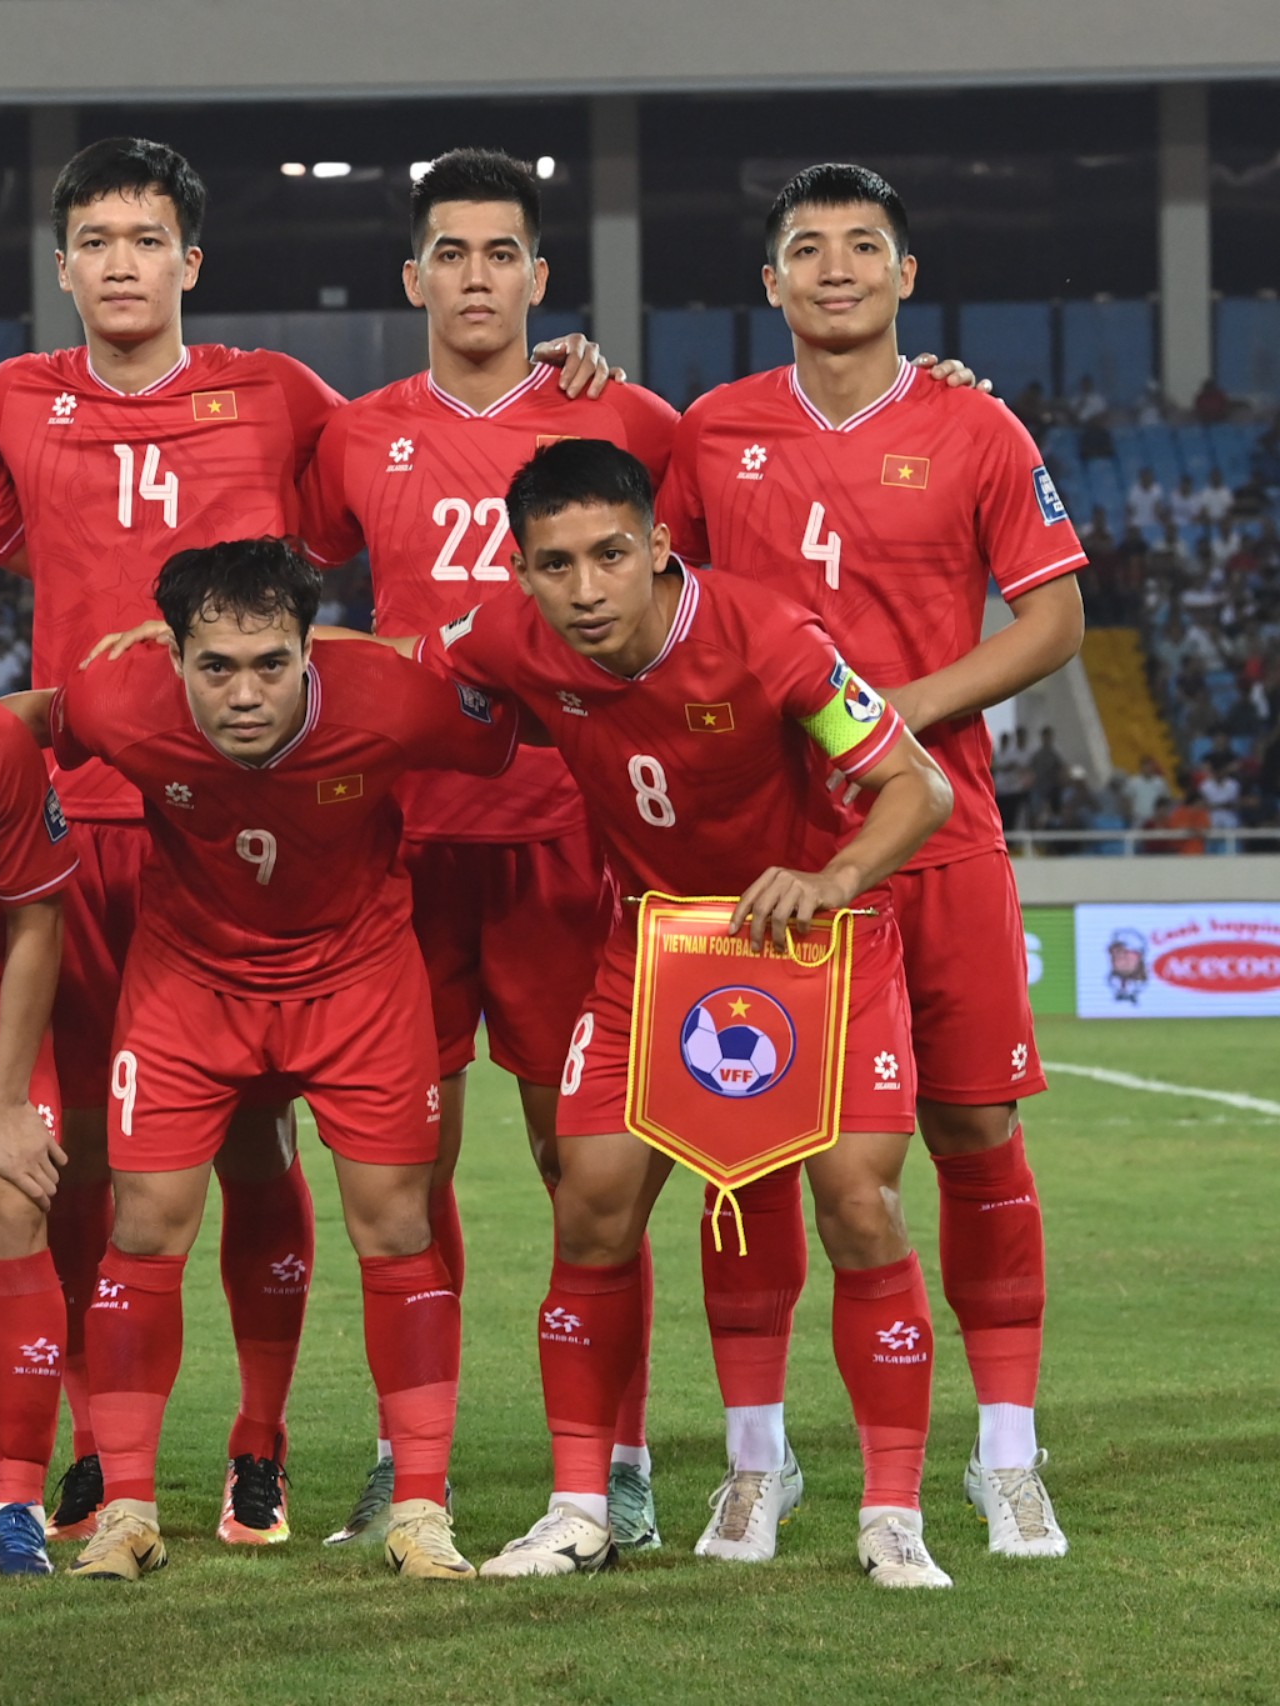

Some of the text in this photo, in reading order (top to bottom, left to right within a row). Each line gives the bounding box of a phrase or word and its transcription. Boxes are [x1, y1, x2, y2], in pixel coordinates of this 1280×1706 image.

[113, 443, 180, 528] 14
[430, 497, 510, 581] 22
[801, 501, 842, 591] 4
[627, 754, 676, 828] 8
[235, 828, 277, 885] 9
[662, 933, 708, 955] VIETNAM
[708, 936, 761, 959] FOOTBAL
[111, 1050, 138, 1137] 9
[560, 1012, 595, 1096] 8
[719, 1068, 754, 1084] VFF
